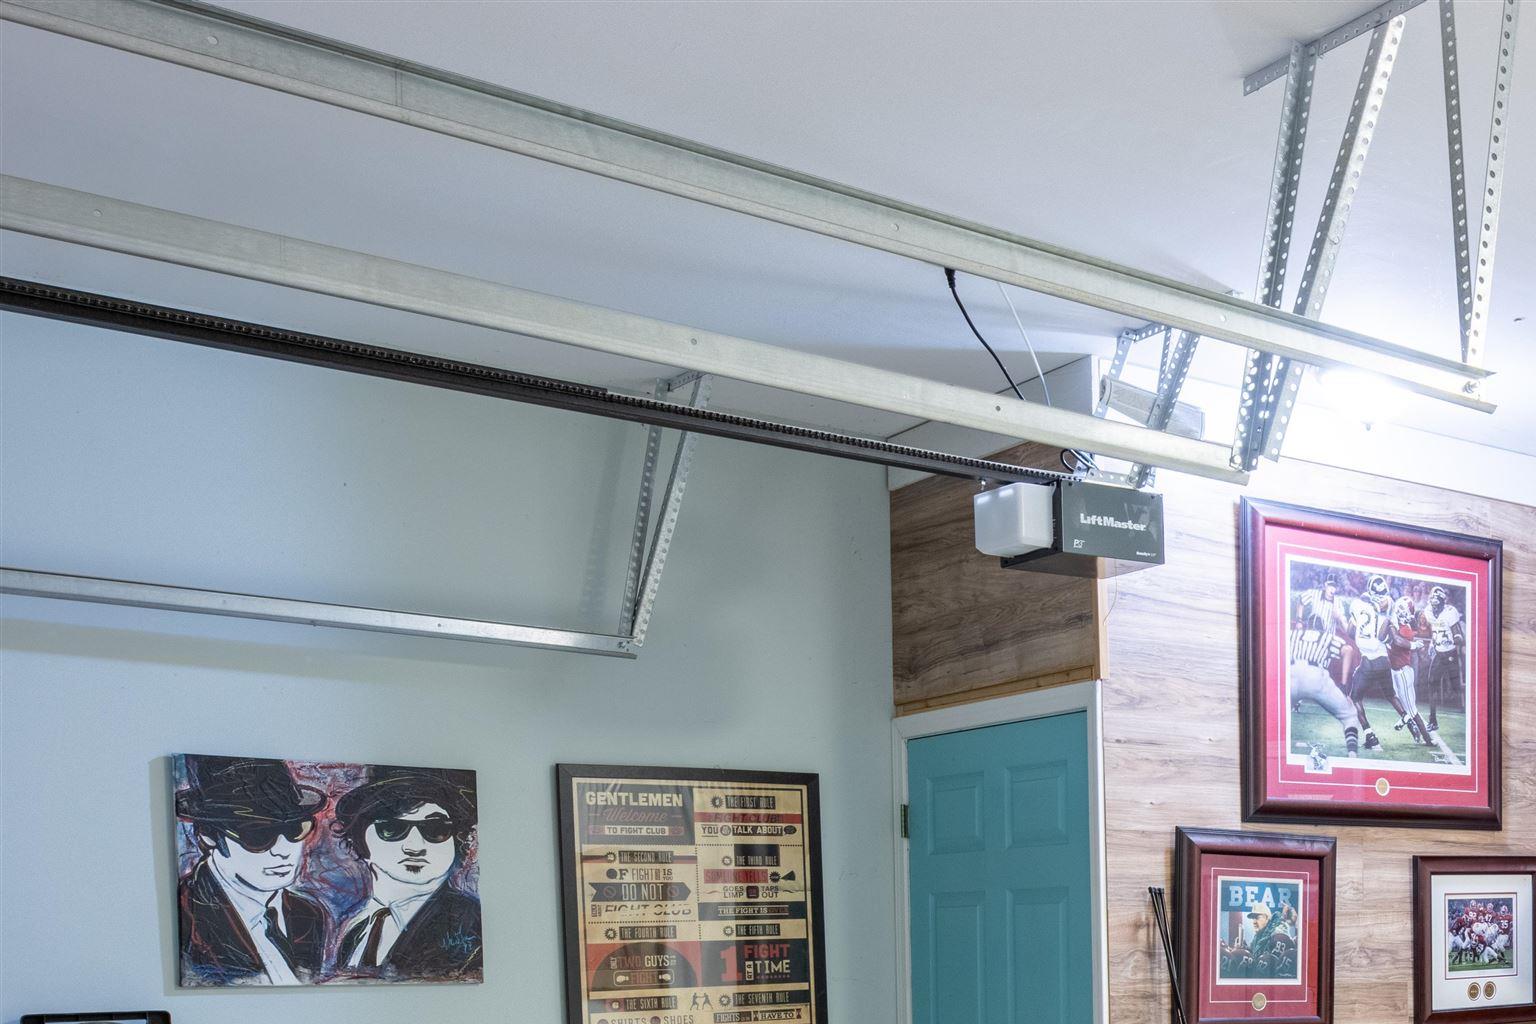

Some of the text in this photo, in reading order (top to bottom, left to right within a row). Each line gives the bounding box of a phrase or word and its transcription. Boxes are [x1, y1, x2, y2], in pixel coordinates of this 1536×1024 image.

[1080, 513, 1146, 531] LiftMaster
[585, 791, 683, 807] GENTLEMEN
[740, 796, 757, 808] FIRST
[603, 808, 668, 822] Welcome
[645, 827, 666, 835] CLUB
[701, 826, 719, 834] YOU
[733, 826, 753, 834] TALK
[756, 826, 782, 834] ABOUT
[634, 852, 656, 863] SECOND
[632, 868, 654, 880] FIGHT
[622, 883, 664, 901] DO NOT
[1229, 885, 1291, 908] BEAR
[634, 927, 657, 938] FOURTH
[743, 944, 790, 958] FIGHT
[644, 955, 670, 967] GUYS
[720, 946, 742, 981] 1
[755, 960, 791, 974] TIME
[639, 997, 659, 1009] SIXTH
[747, 992, 773, 1004] SEVENTH
[716, 1013, 740, 1022] FIGHTS
[760, 1011, 780, 1020] HAVE
[783, 1011, 794, 1019] TO
